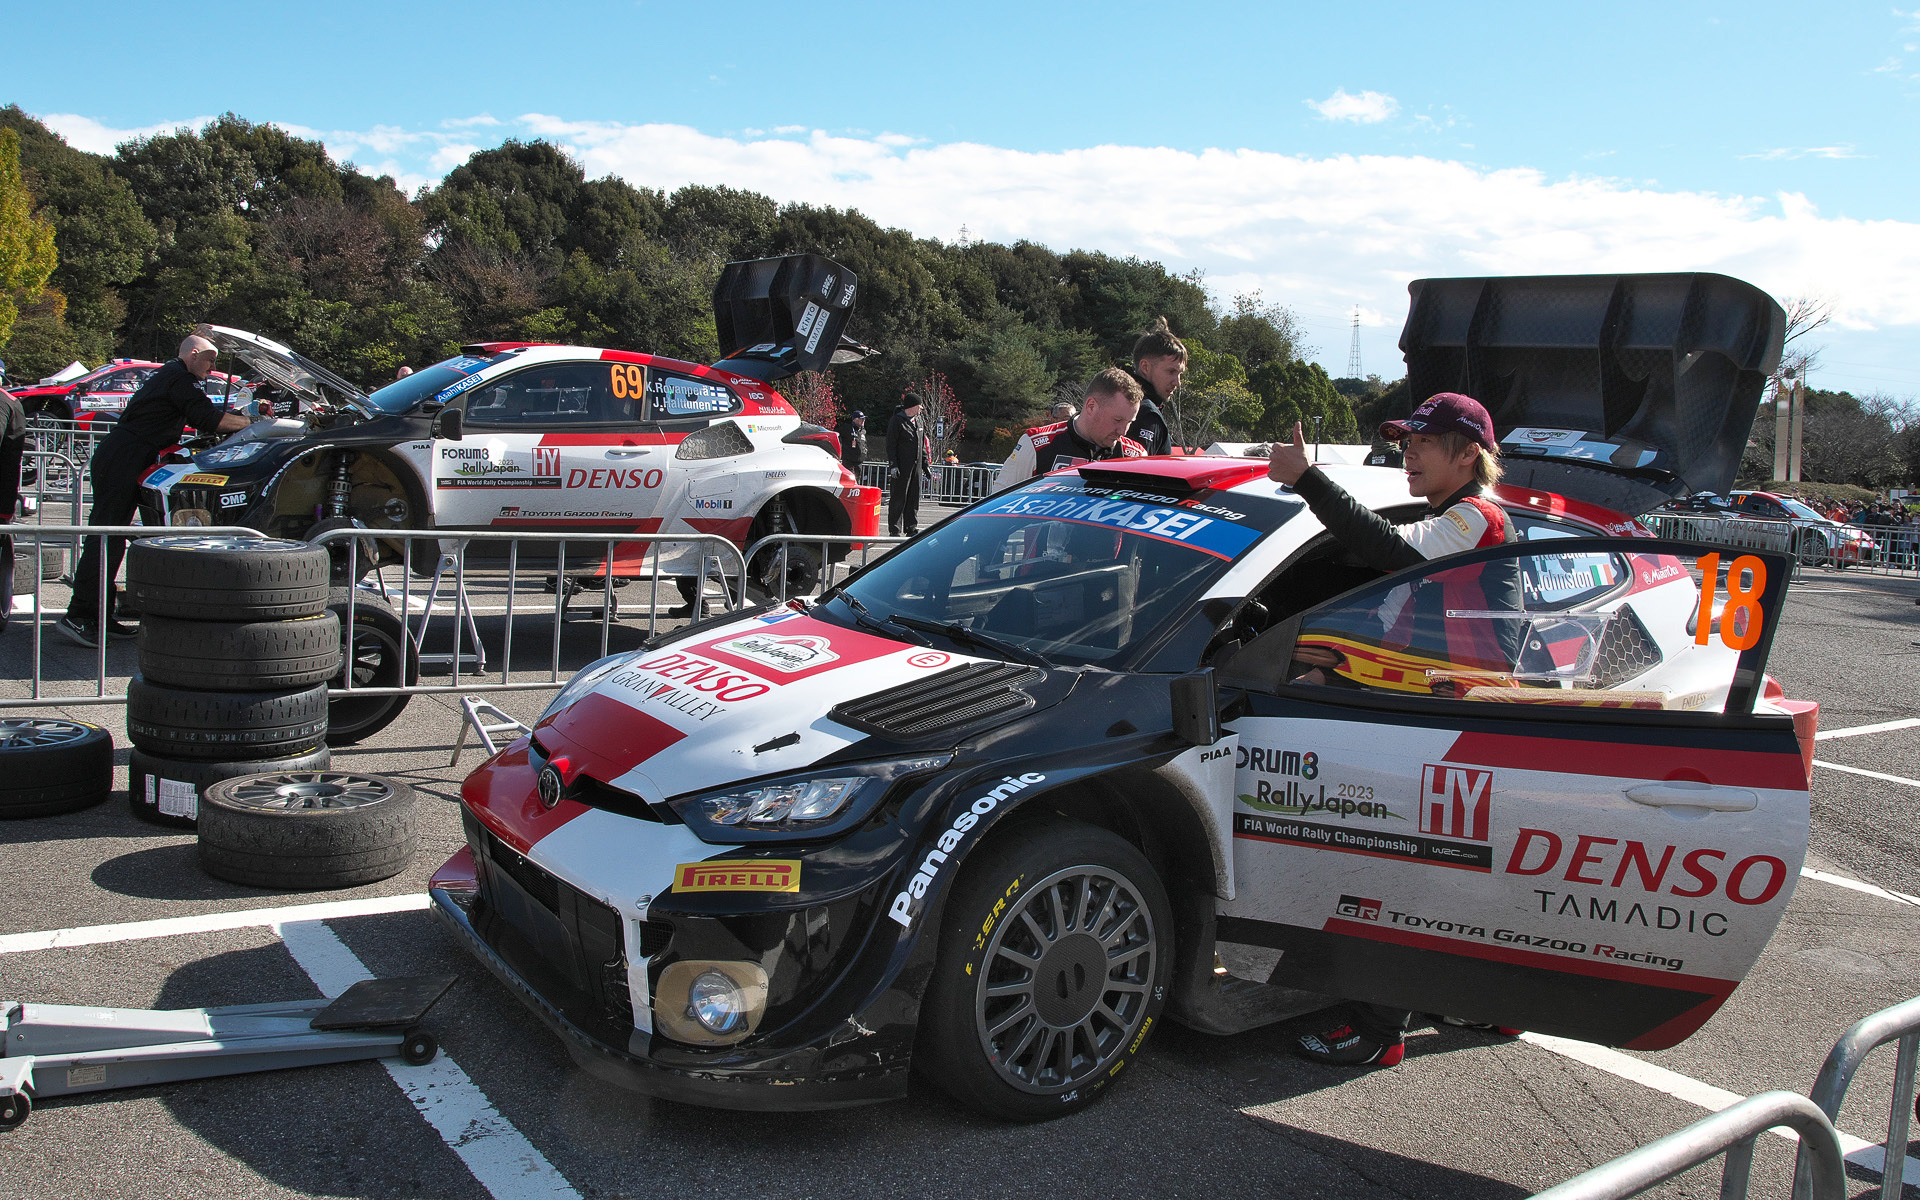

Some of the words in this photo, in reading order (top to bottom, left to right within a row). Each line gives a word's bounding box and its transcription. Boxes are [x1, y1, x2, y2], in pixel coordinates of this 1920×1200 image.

[437, 374, 481, 402] AsahiKASEI
[611, 364, 643, 399] 69
[442, 448, 489, 460] FORUM8
[1033, 437, 1050, 446] OMP
[463, 462, 520, 476] RallyJapan
[532, 448, 559, 476] HY
[182, 475, 225, 484] PIRELLI
[566, 468, 663, 489] DENSO
[220, 494, 247, 505] OMP
[600, 510, 634, 519] Racing
[695, 500, 722, 509] Mobil
[724, 500, 732, 509] 1
[1050, 485, 1112, 495] TOYOTA
[1113, 489, 1179, 504] GAZOO
[1178, 499, 1247, 520] Racing
[1737, 495, 1748, 505] 17
[990, 495, 1214, 540] AsahiKASEI
[1695, 552, 1767, 651] 18
[637, 653, 771, 703] DENSO
[611, 671, 726, 722] GRANVALLEY
[1200, 746, 1232, 763] PIAA
[1236, 746, 1319, 781] ORUM8
[1257, 780, 1387, 820] RallyJapan
[1338, 783, 1374, 801] 2023
[1420, 765, 1491, 839] HY
[888, 771, 1046, 929] Panasonic
[1244, 818, 1263, 832] FIA
[1266, 821, 1299, 836] World
[1302, 826, 1331, 843] Rally
[1335, 831, 1418, 854] Championship
[682, 864, 792, 888] PIRELLI
[1505, 827, 1787, 906] DENSO
[1534, 889, 1729, 937] TAMADIC
[1338, 900, 1381, 921] GR
[1388, 910, 1486, 938] TOYOTA
[1493, 929, 1586, 954] GAZOO
[1592, 944, 1684, 971] Racing
